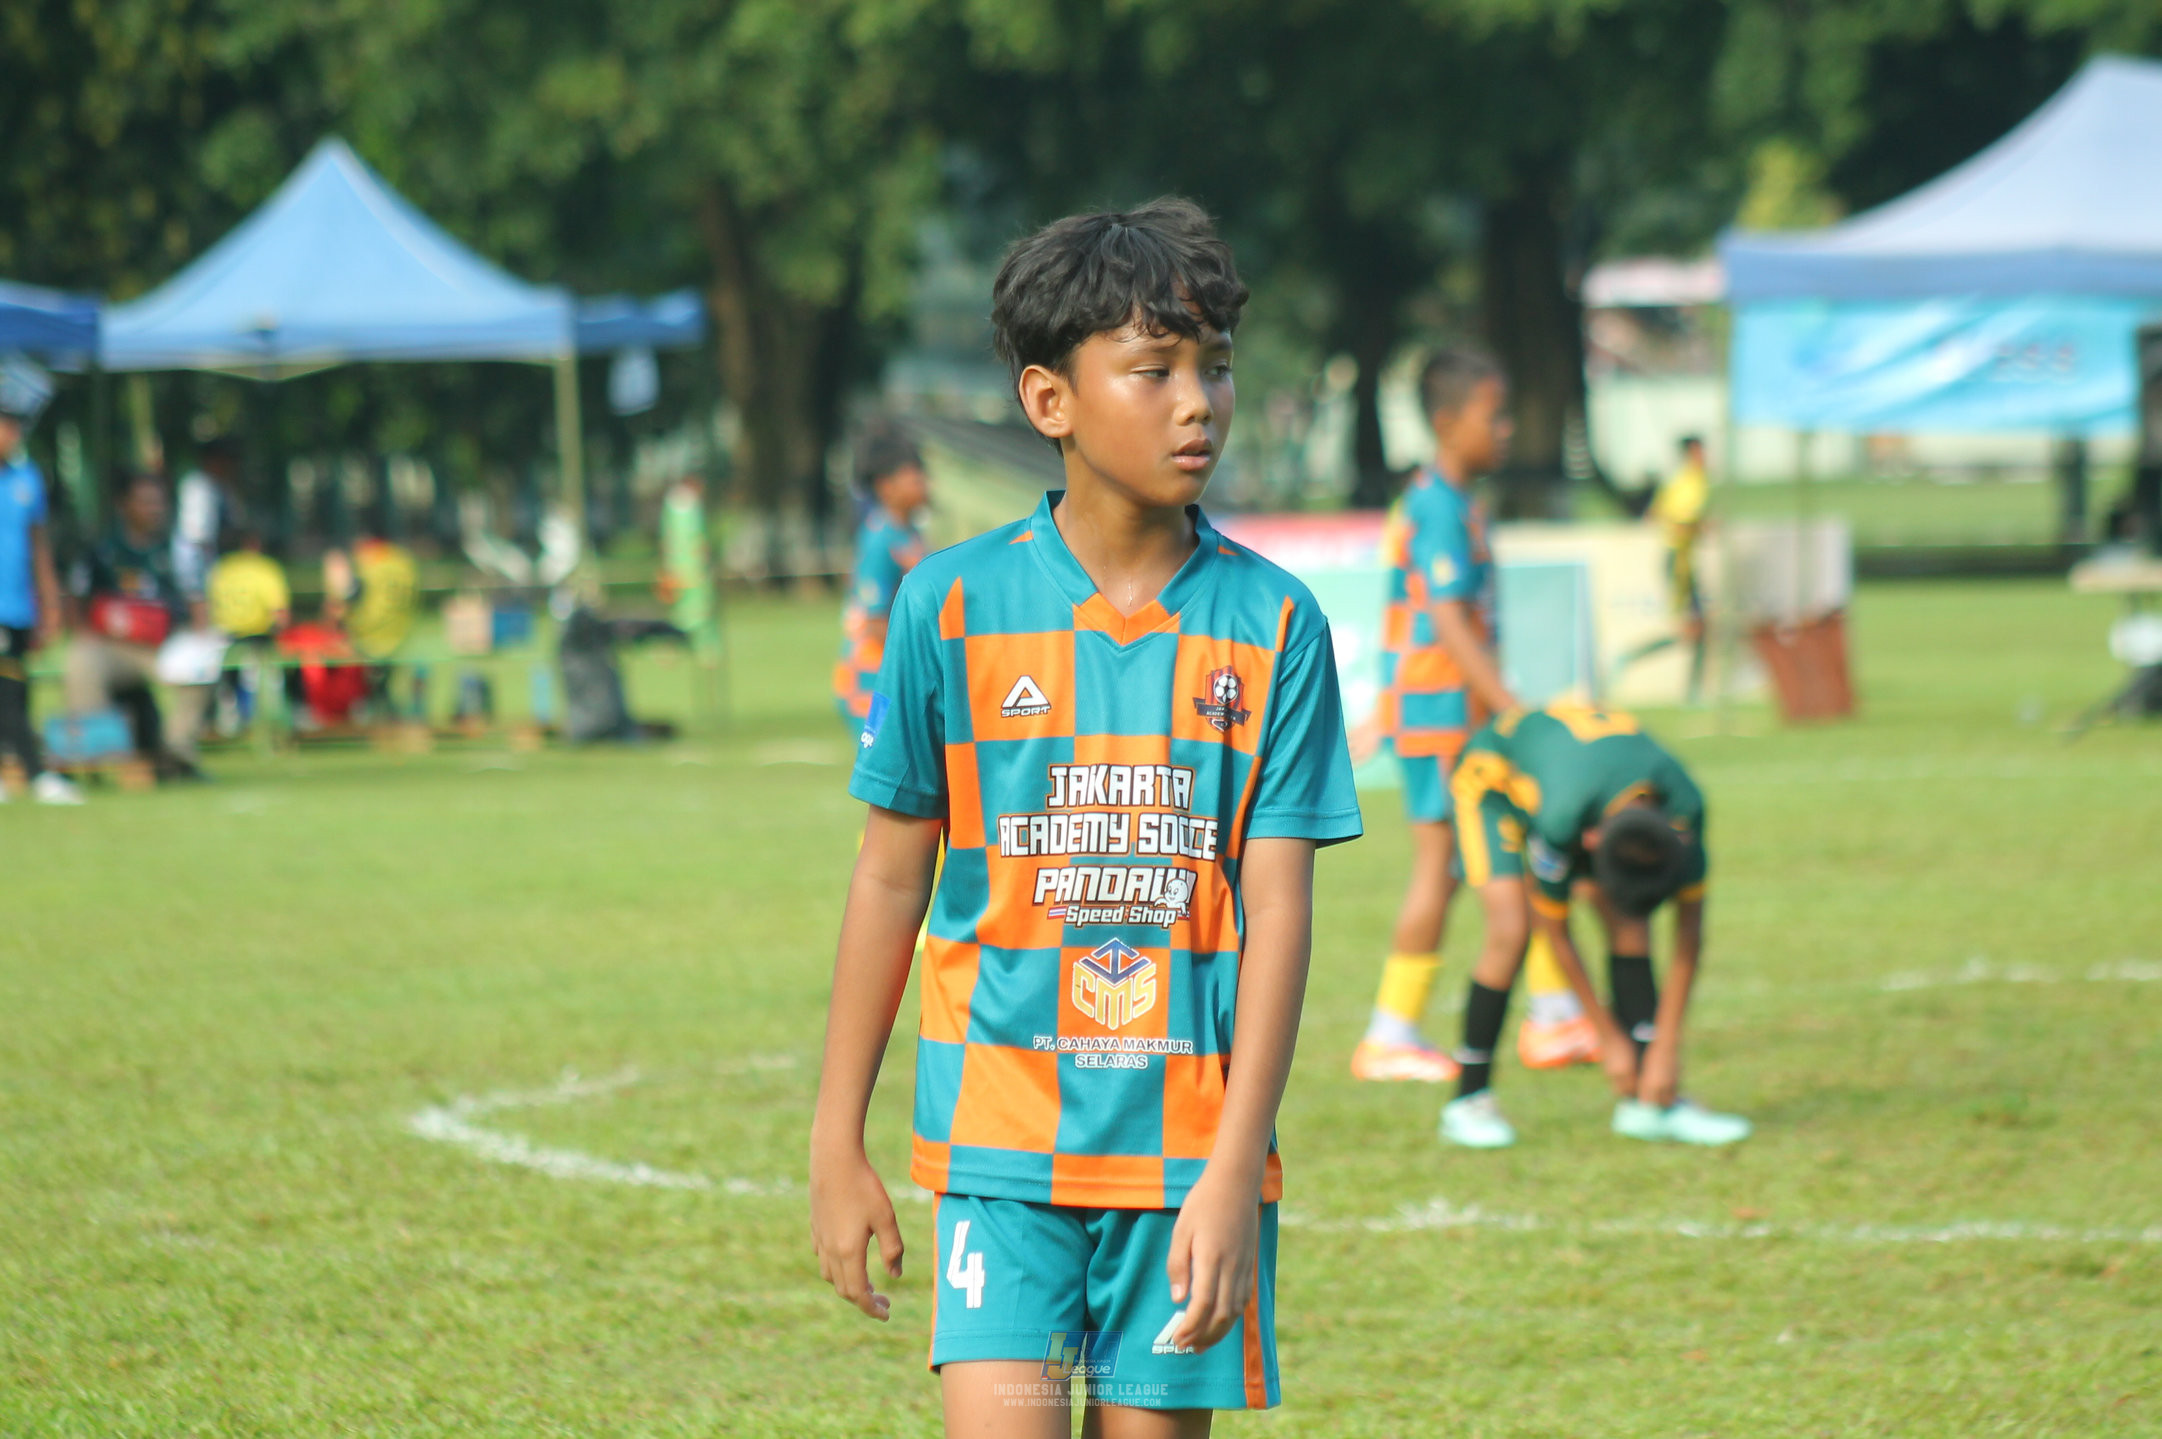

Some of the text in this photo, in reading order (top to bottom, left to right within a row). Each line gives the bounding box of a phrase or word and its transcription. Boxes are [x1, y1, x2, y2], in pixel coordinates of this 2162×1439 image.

[1001, 705, 1051, 717] SPORT
[1047, 764, 1194, 810] JAKARTA
[999, 813, 1219, 861] ACADEMY SOCCE
[1064, 905, 1178, 928] Speed Shop
[1072, 961, 1157, 1031] CMS
[1033, 1036, 1193, 1054] PT. CAHAYA MAKMUR
[1075, 1053, 1148, 1069] SELARAS
[946, 1220, 985, 1309] 4
